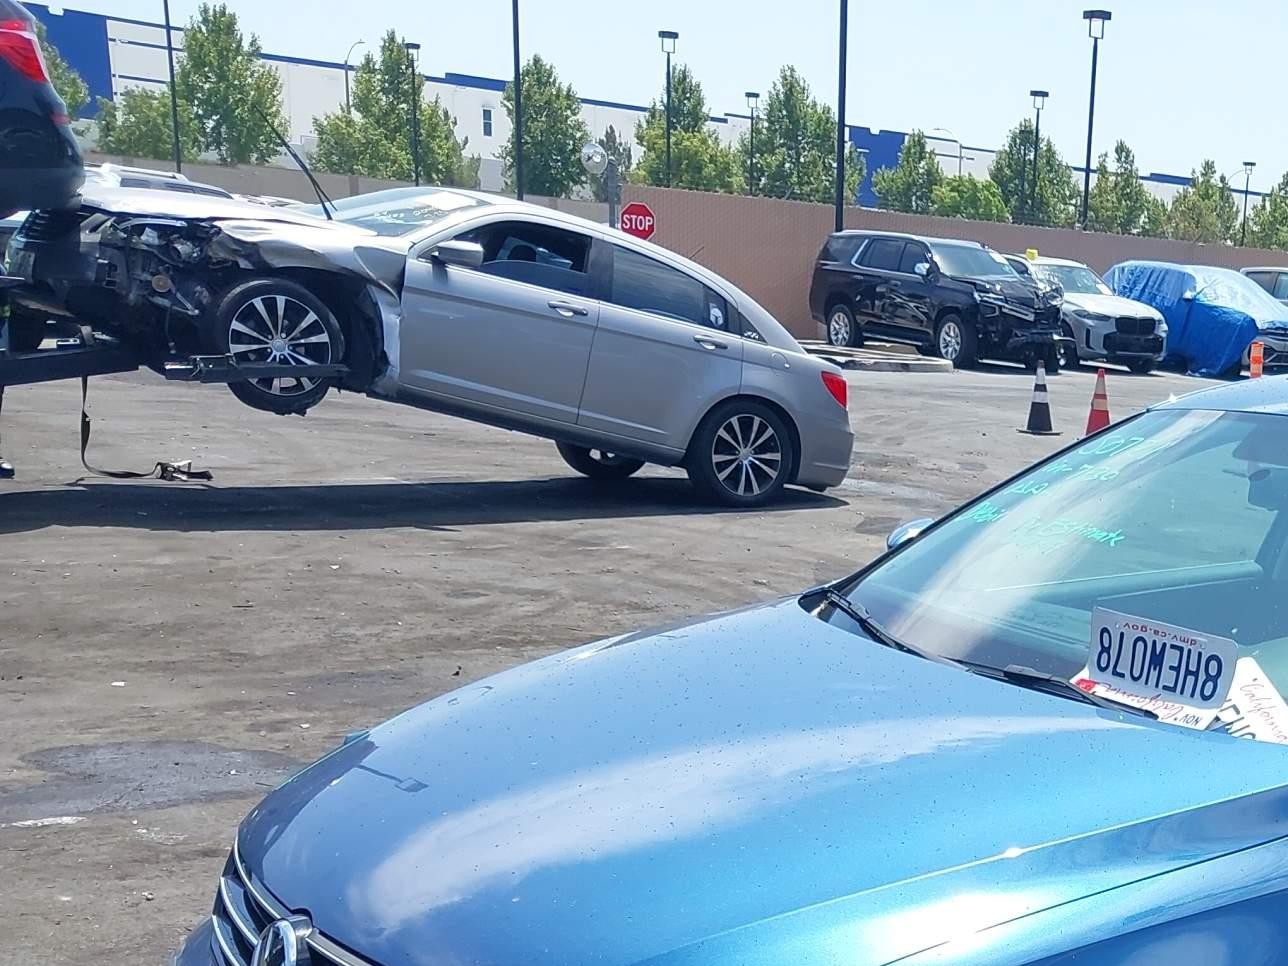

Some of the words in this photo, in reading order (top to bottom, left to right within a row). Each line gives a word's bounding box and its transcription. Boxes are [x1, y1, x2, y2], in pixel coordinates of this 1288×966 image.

[622, 213, 653, 231] STOP
[1123, 621, 1198, 647] dmv.ca.gov
[1095, 626, 1223, 702] 8HEW078
